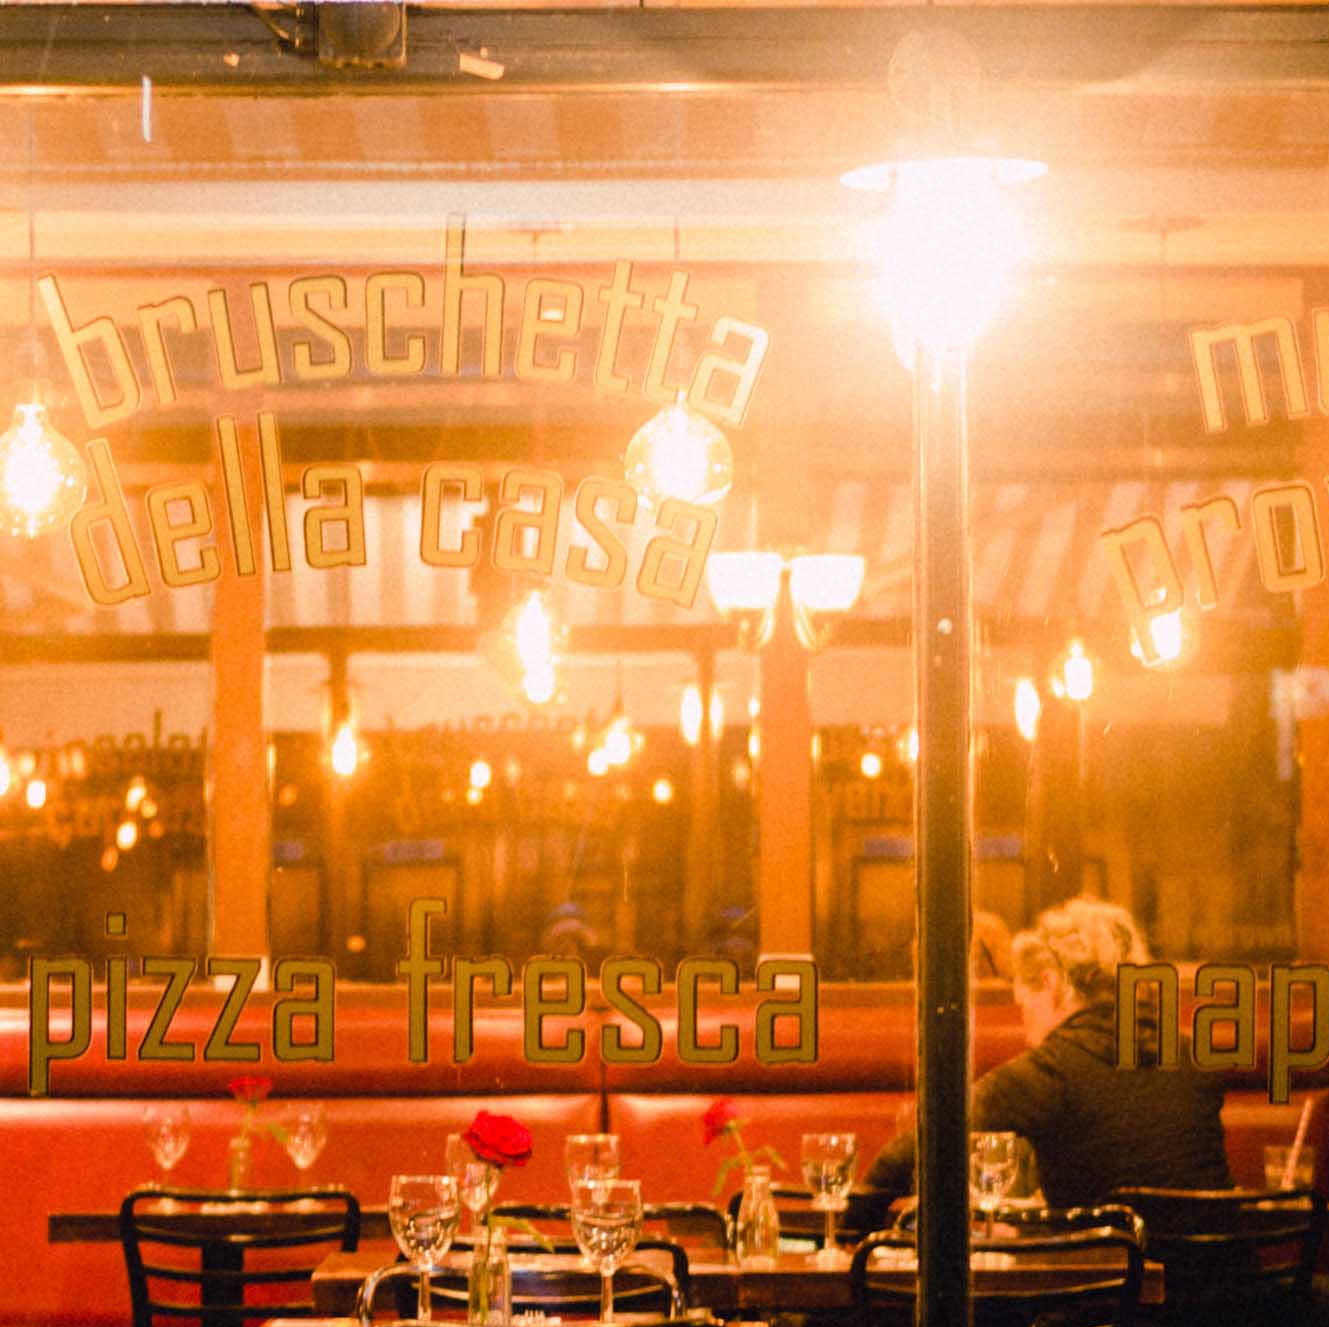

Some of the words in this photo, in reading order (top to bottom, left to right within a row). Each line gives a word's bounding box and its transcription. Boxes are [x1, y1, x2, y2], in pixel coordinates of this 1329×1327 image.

[38, 213, 770, 430] bruschetta
[70, 413, 367, 605] della
[421, 461, 719, 608] casa
[29, 912, 335, 1096] pizza
[398, 897, 818, 1065] fresca
